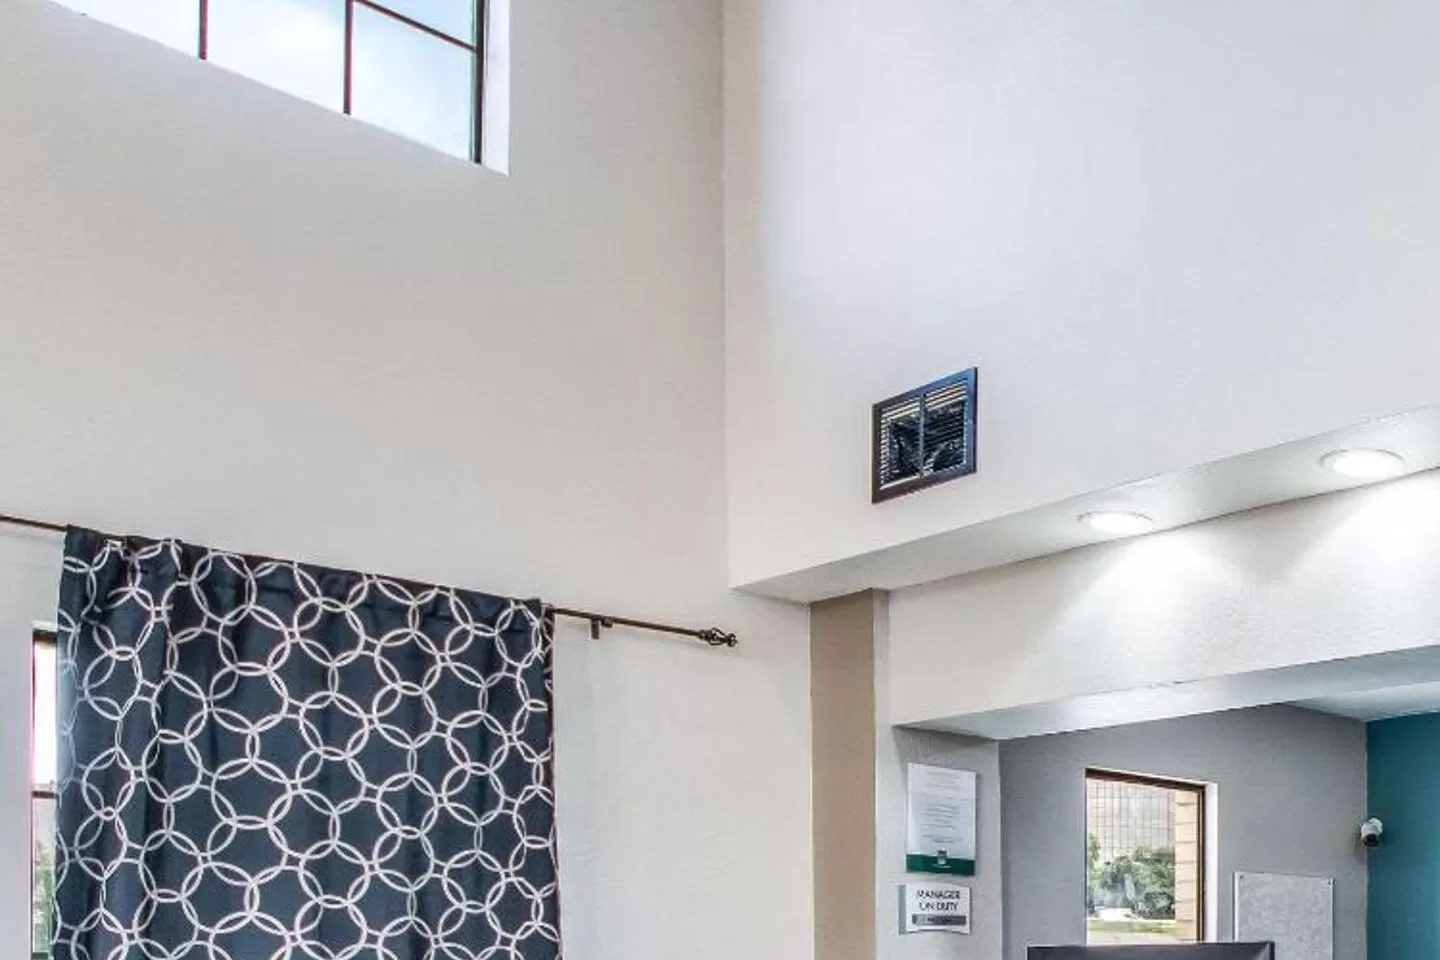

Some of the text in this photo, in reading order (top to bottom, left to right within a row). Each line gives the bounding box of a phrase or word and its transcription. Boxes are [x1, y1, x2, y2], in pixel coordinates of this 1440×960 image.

[916, 889, 961, 899] MANAGER
[919, 902, 959, 911] ON DUTY
